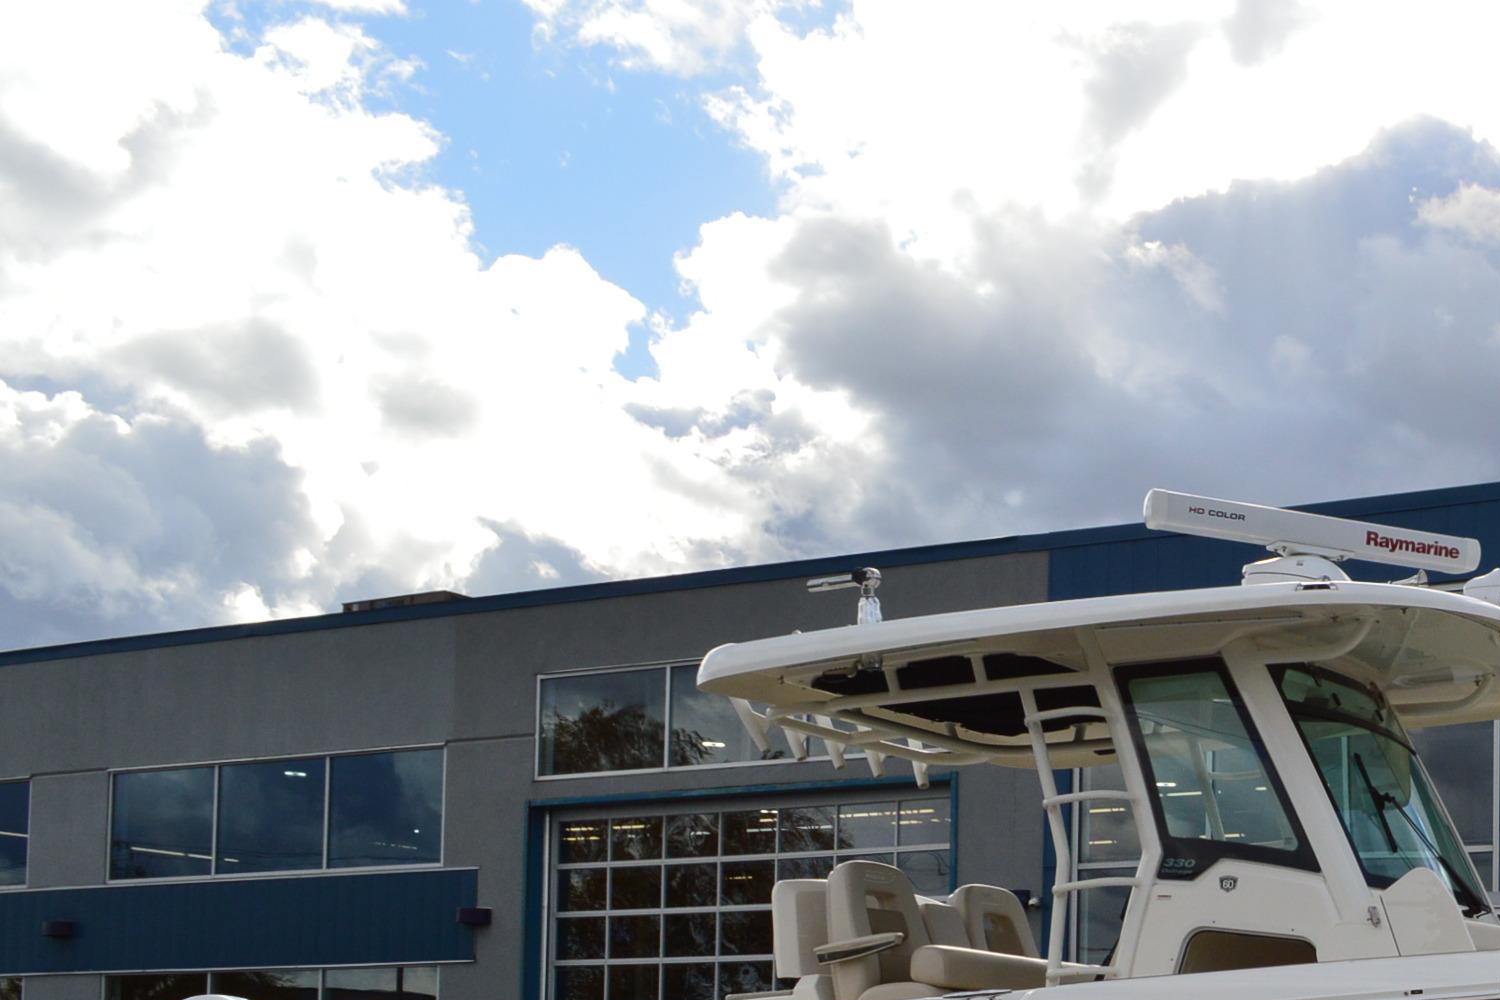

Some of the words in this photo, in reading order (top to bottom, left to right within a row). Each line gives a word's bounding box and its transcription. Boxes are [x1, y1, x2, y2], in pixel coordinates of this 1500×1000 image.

[1188, 506, 1205, 515] HD
[1208, 509, 1246, 521] COLOR
[1366, 530, 1460, 559] Raymarine
[1163, 857, 1196, 868] 330
